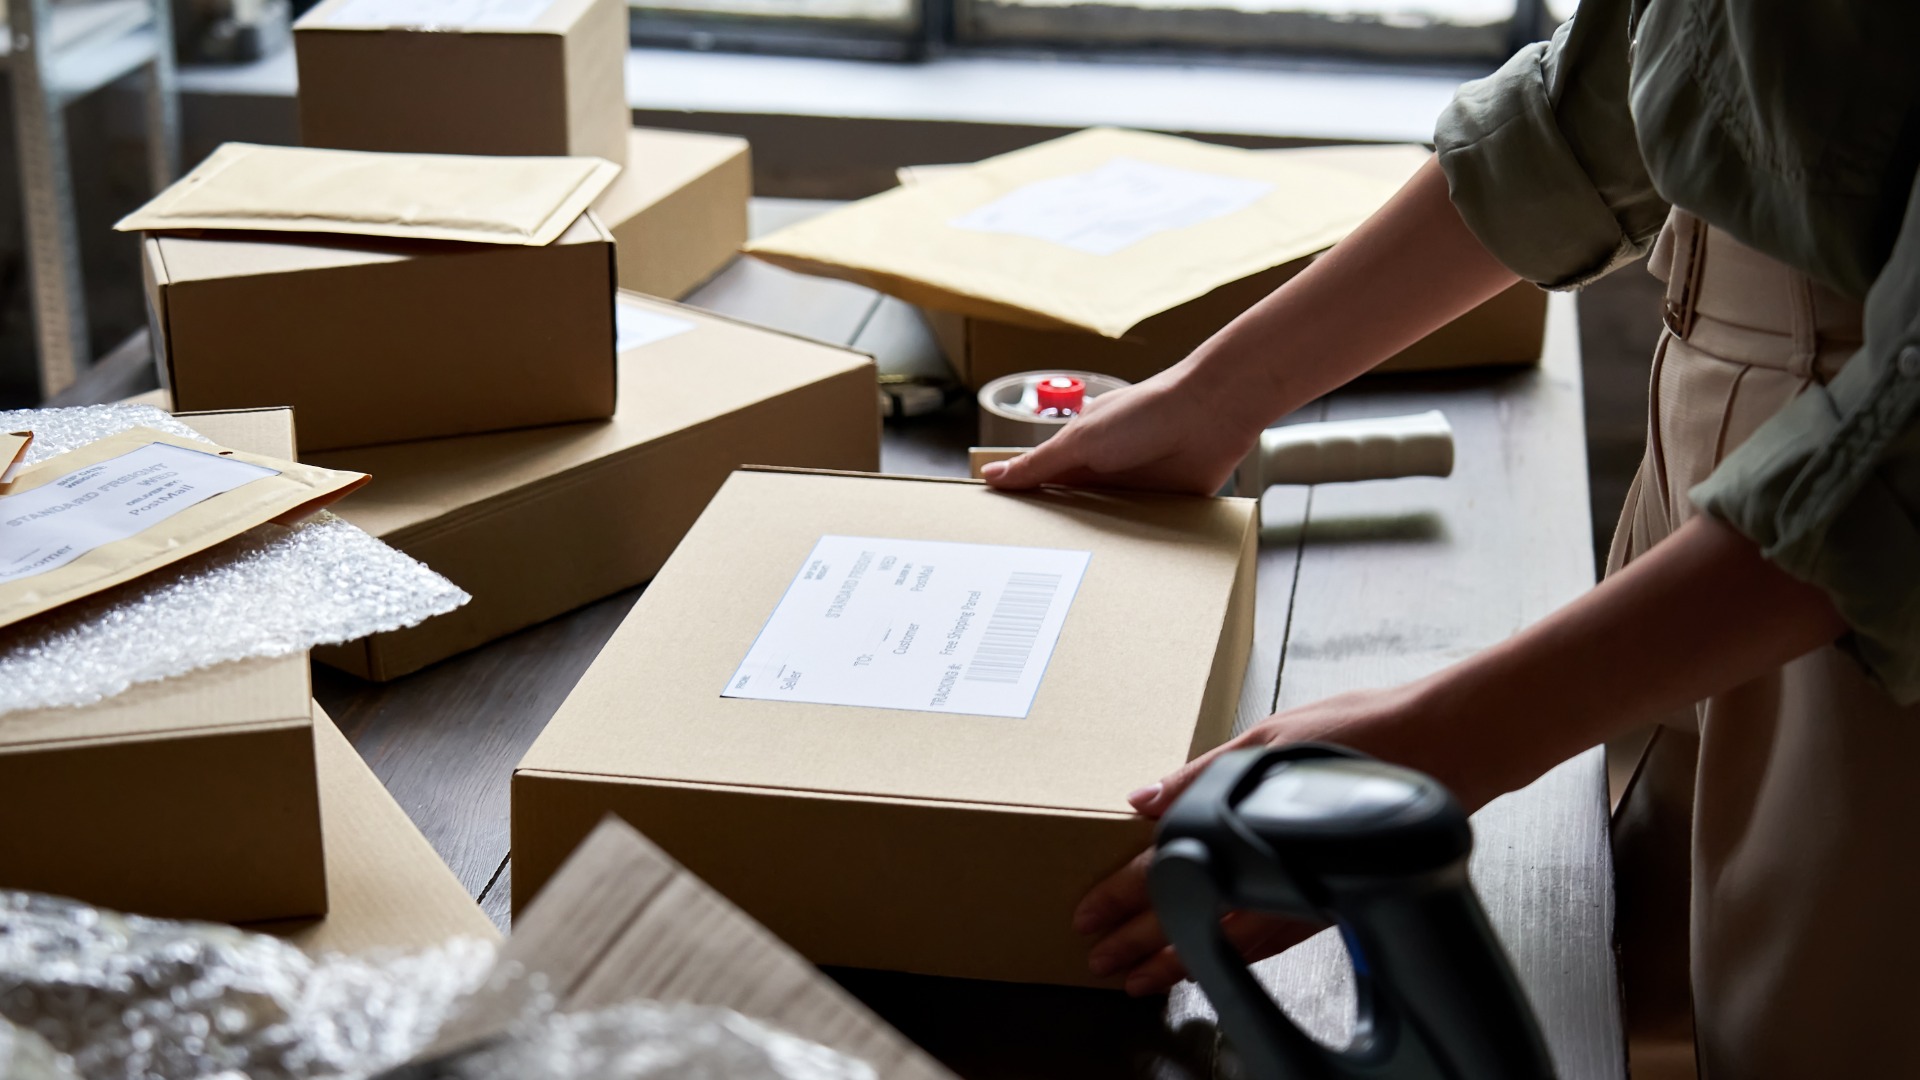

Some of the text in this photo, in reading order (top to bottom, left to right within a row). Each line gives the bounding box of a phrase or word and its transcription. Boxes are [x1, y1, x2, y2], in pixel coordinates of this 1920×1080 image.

[6, 462, 168, 528] STANDARD FREIGHT
[136, 471, 179, 487] WED
[128, 484, 195, 516] PostMail
[909, 565, 936, 592] PostMail
[825, 579, 859, 618] STANDARD
[892, 622, 920, 655] Customer
[939, 590, 981, 656] Free Shipping Parcel
[780, 671, 803, 691] Seller
[930, 671, 959, 706] TRACKING
